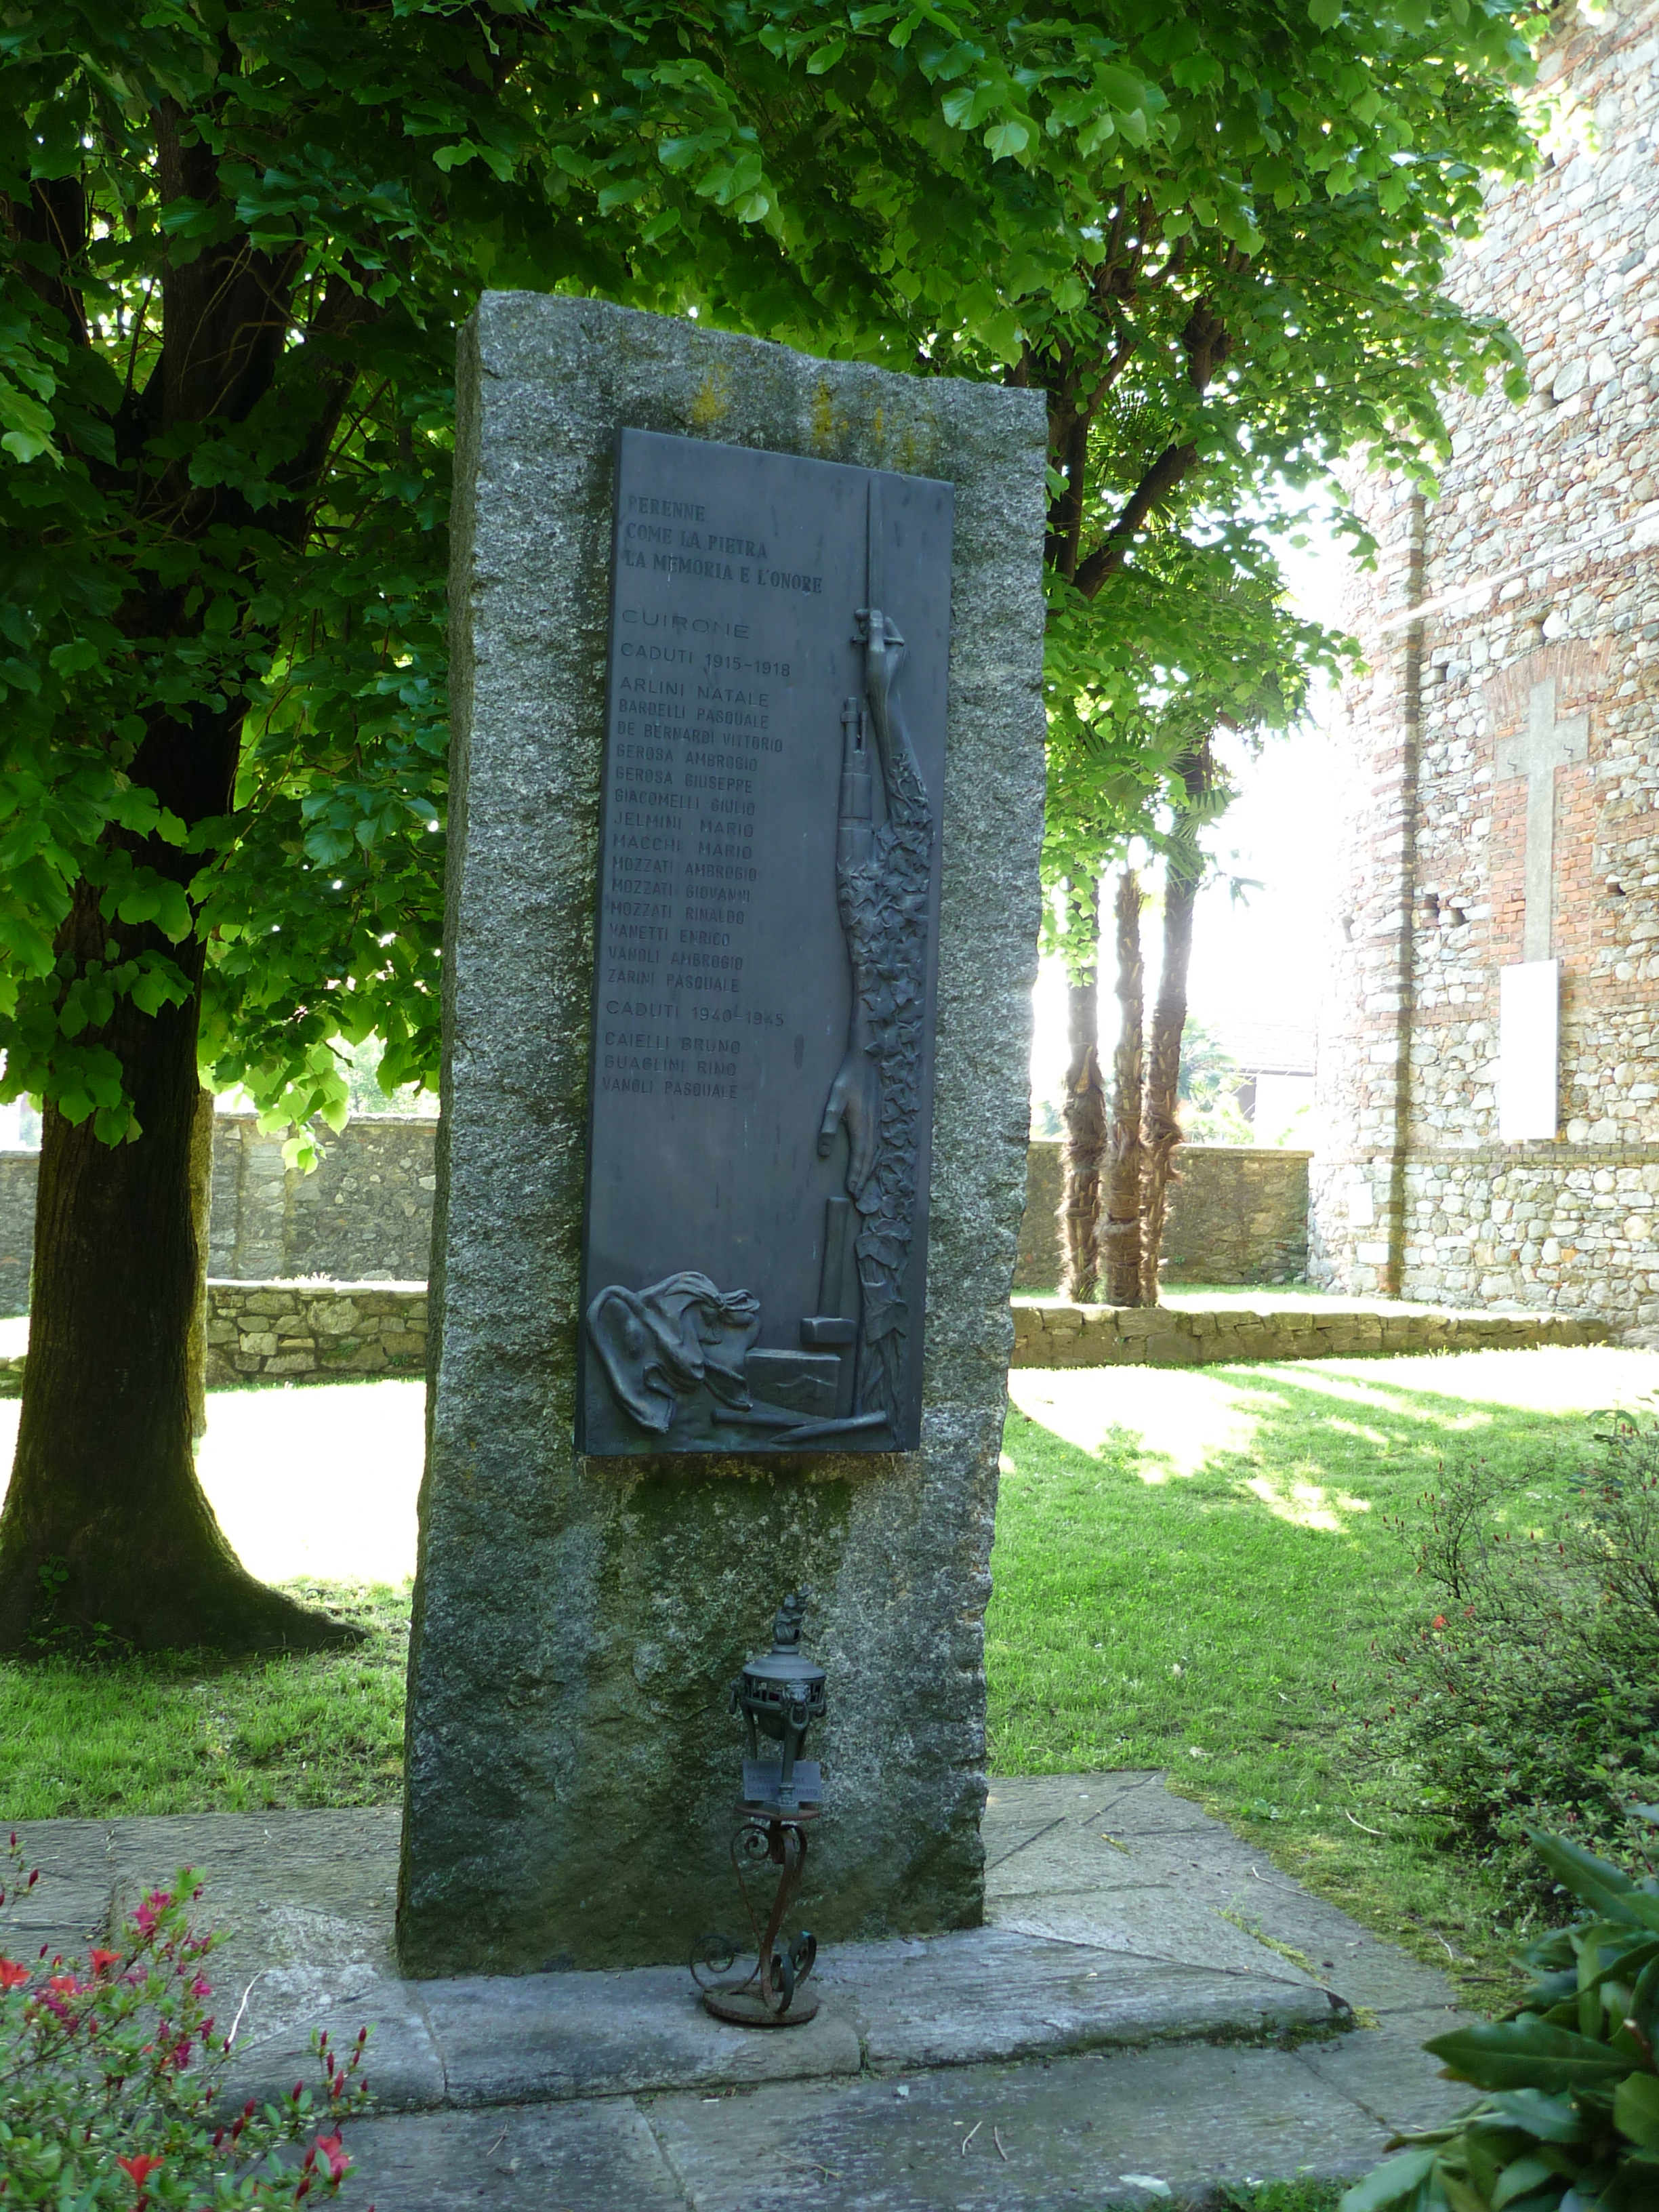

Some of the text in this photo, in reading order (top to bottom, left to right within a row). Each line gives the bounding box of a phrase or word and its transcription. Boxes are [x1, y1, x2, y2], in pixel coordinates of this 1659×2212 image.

[628, 495, 705, 522] PERENNE
[626, 523, 767, 558] COME LA PIETRA
[625, 550, 823, 594] LA MEMORIA E L'ONORE
[622, 609, 750, 639] CUIRONE
[621, 642, 790, 677] CADUTI 1915-1918
[620, 676, 769, 708] ARLINI NATALE
[619, 699, 769, 729] BARDELLI PASQUALE
[617, 721, 783, 752] DE BERNARDI VITTORIO
[617, 744, 758, 772] GEROSA AMBROGIO
[616, 766, 752, 793] GEROSA GIUSEPPE
[615, 789, 755, 815] GIACOMELLI GIULIO
[614, 811, 754, 838] JELMINI MARIO
[613, 834, 752, 859] MACCHI MARIO
[612, 856, 756, 881] MOZZATI AMBROGIO
[611, 879, 750, 902] MOZZATI GIOVANNI
[611, 902, 744, 924] MOZZATI RINALDO
[609, 924, 730, 946] VANETTI ENRICO
[609, 946, 743, 970] VANOLI AMBROGIO
[607, 969, 739, 992] ZARINI PASQUALE
[606, 1001, 784, 1027] CADUTI 1940-1945
[605, 1032, 741, 1054] CAIELLI BRUNO
[604, 1055, 736, 1076] GUAGLINI RINO
[602, 1078, 737, 1099] VANOLI PASQUALE
